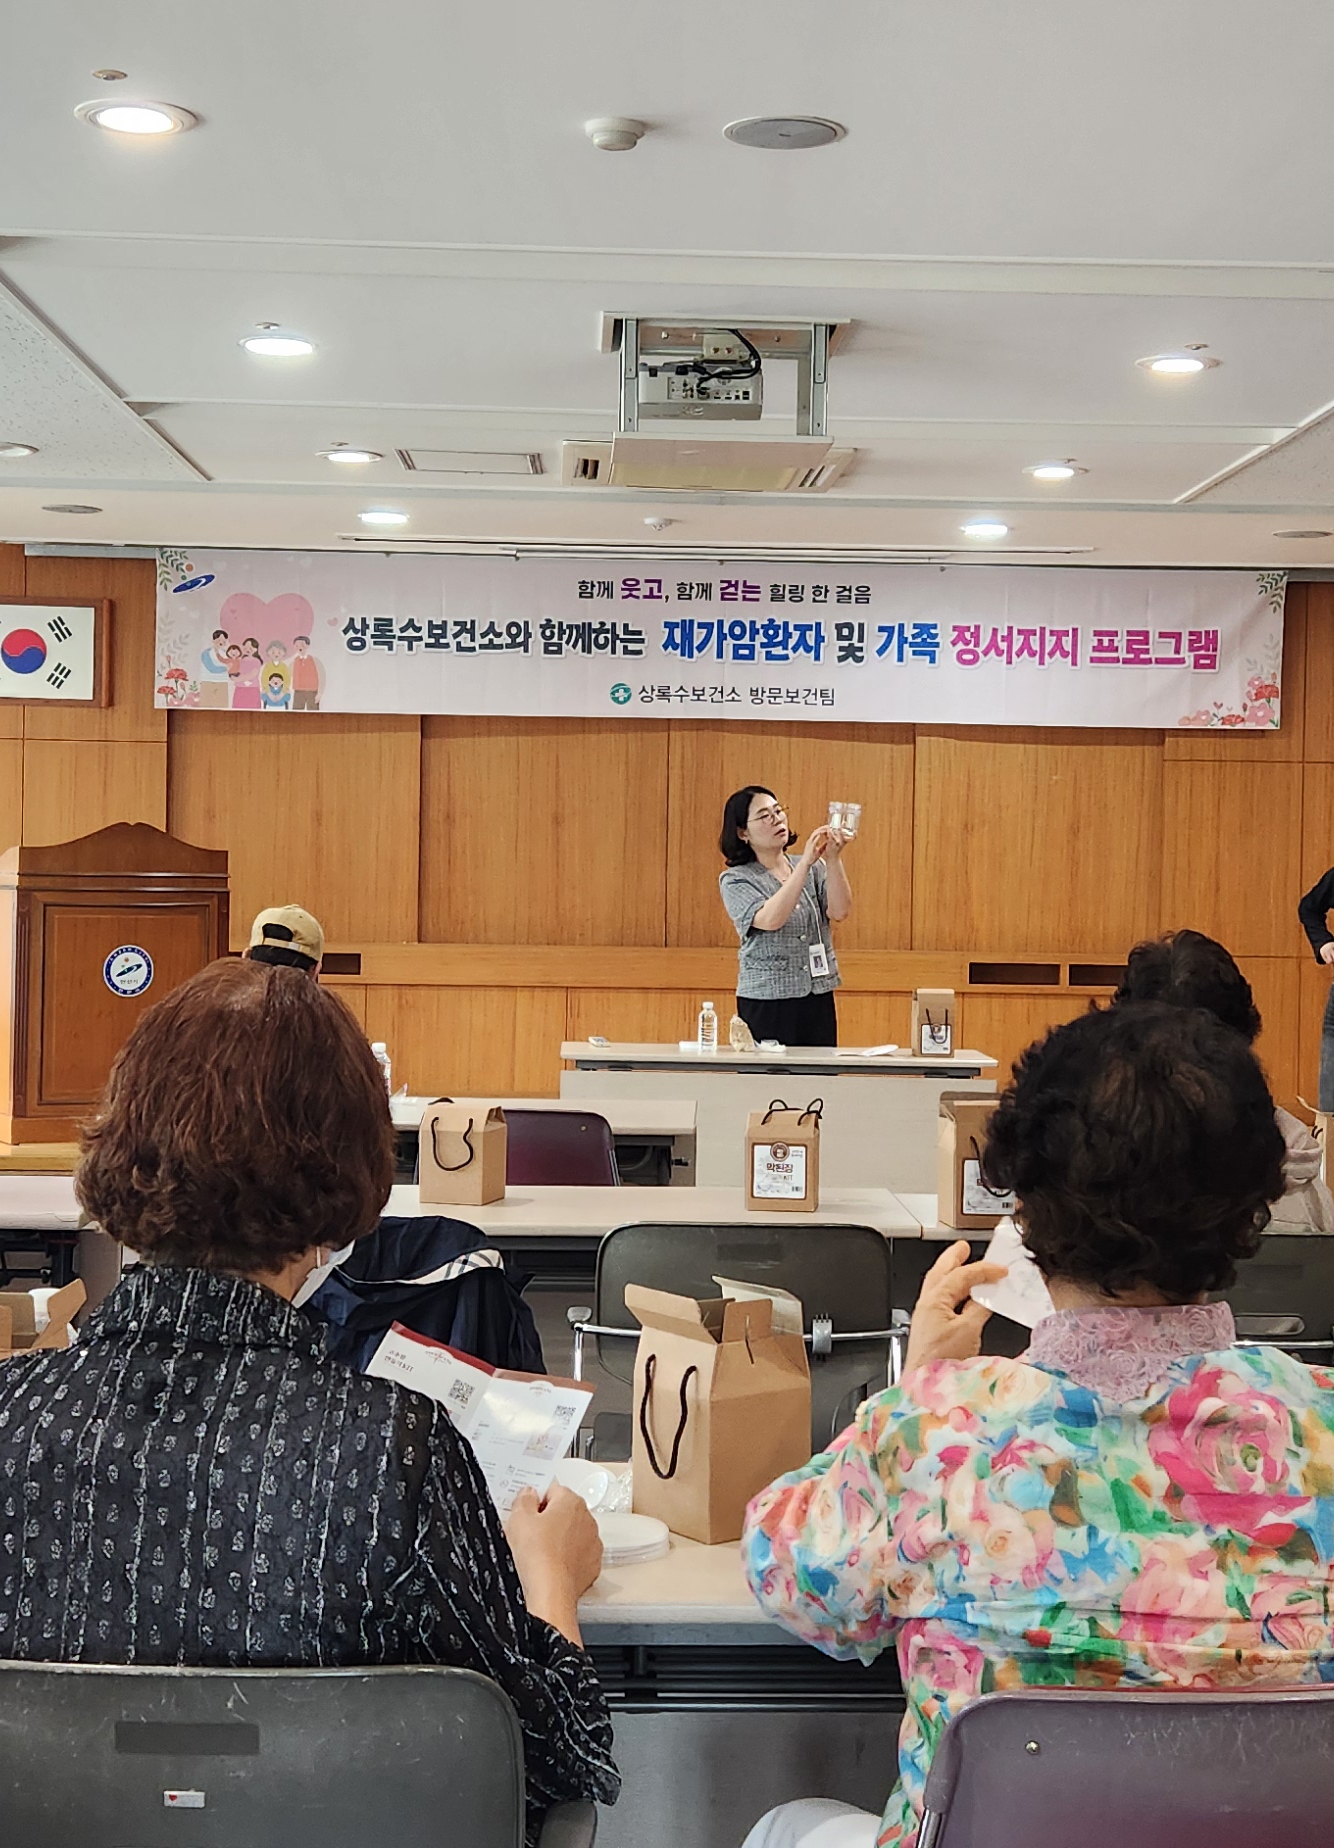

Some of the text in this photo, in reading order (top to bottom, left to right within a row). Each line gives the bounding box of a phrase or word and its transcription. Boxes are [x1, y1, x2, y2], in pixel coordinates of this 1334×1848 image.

[577, 577, 872, 605] 함께 웃고, 함께 걷는 힐링 한 걸음
[342, 616, 1220, 671] 상록수보건소와 함께하는 재가암환자 및 가족 정서지지 프로그램
[638, 685, 836, 707] 상록수보건소 방문보건팀
